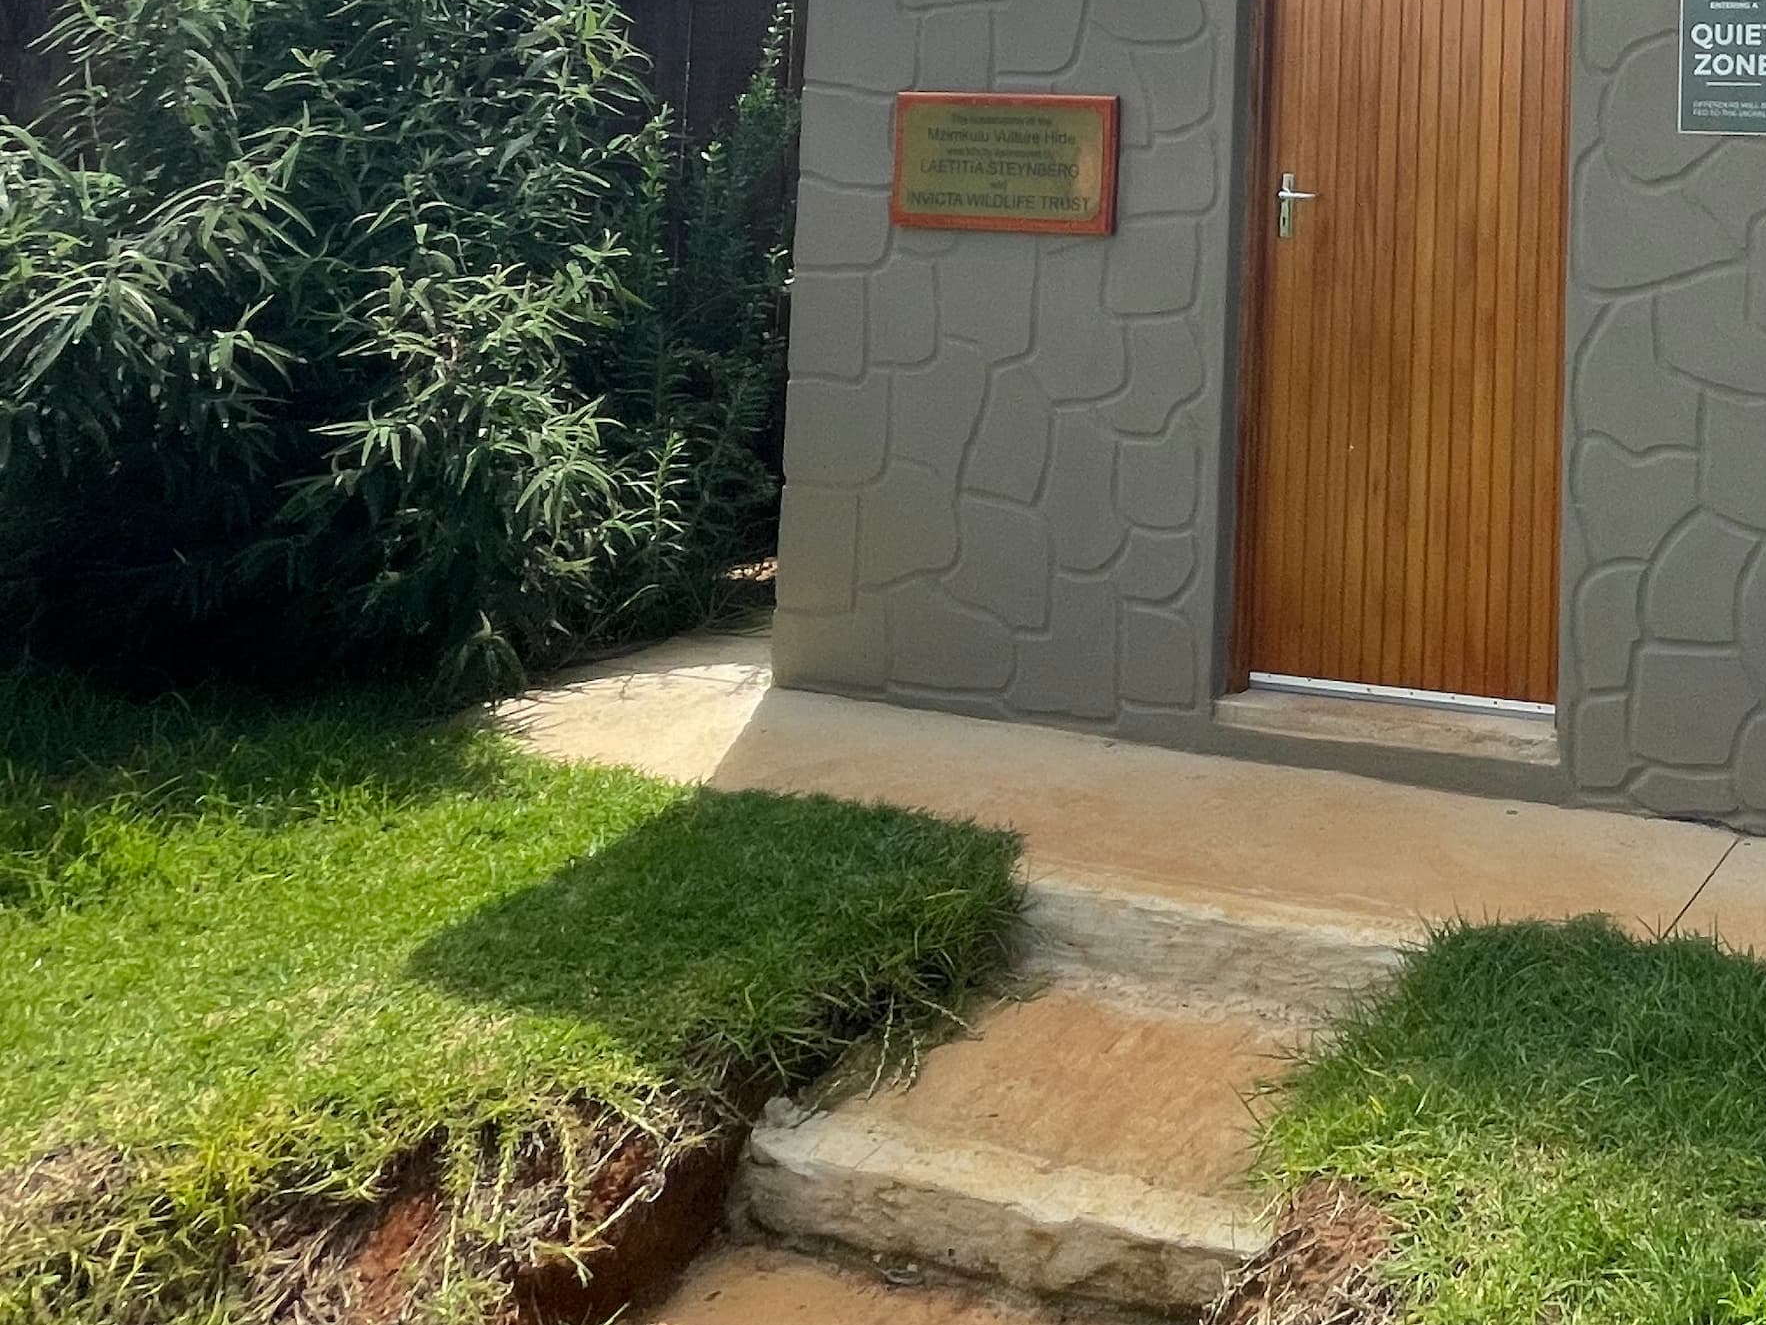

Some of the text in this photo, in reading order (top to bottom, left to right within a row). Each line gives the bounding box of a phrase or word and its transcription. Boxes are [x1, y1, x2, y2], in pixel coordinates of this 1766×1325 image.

[928, 127, 1076, 145] Mzimkulu Vulture Hide
[920, 160, 1080, 179] LAETITIA STEYNBERG
[907, 191, 1091, 213] INVICTA WILDLIFE TRUST
